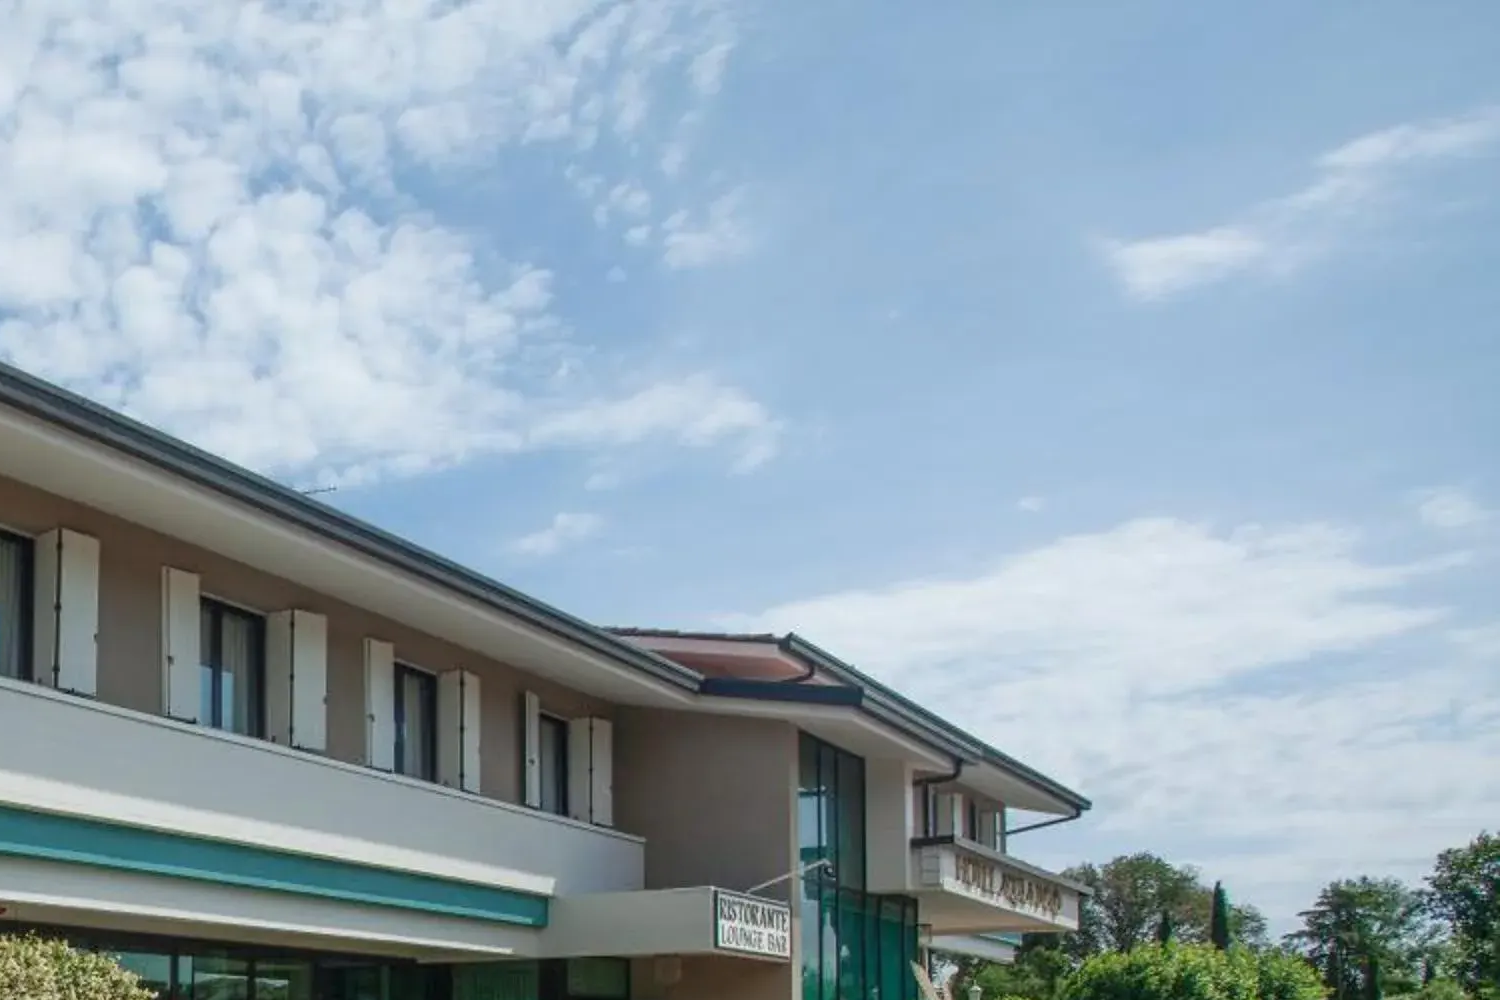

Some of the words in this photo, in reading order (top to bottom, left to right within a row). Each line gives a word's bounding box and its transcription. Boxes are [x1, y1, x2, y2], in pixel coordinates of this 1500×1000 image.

[719, 896, 789, 933] RISTORANTE
[721, 924, 765, 949] LOUNGE
[767, 932, 787, 953] BAR
